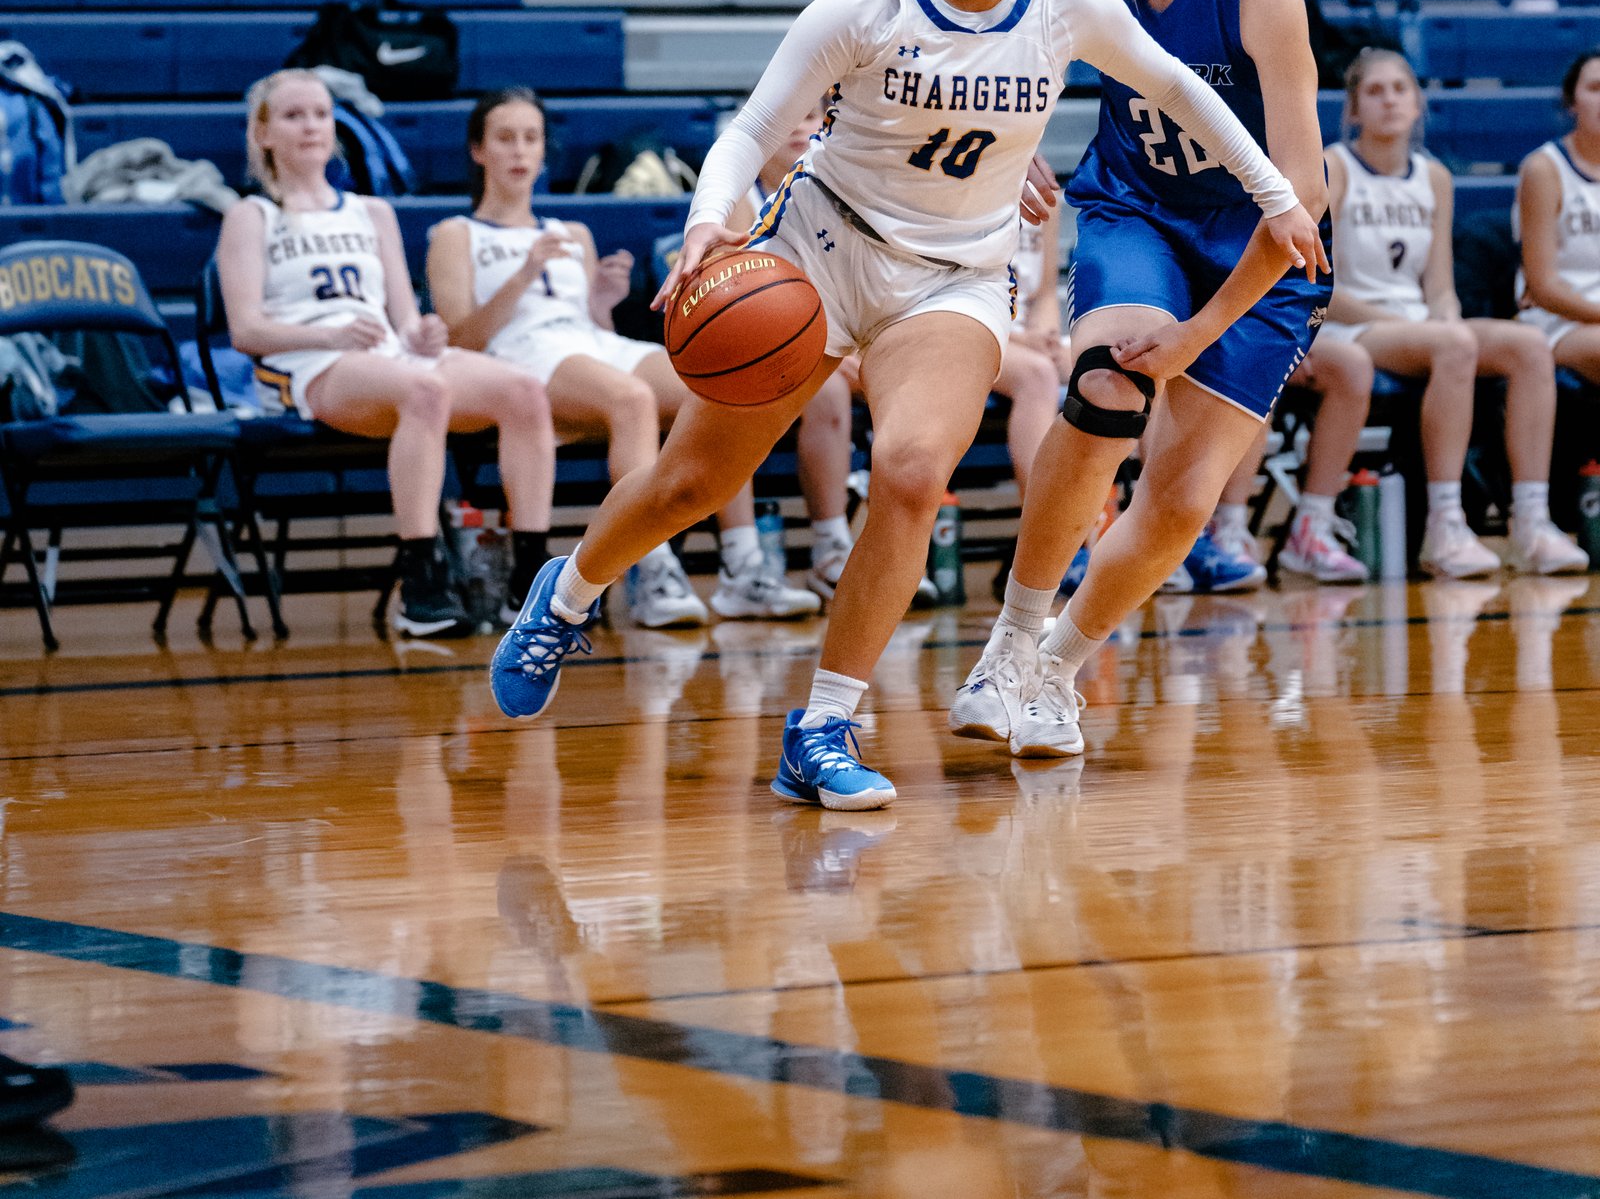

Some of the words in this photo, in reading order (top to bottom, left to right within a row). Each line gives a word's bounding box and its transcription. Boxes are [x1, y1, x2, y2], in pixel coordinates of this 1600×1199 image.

[884, 67, 1050, 113] CHARGERS
[906, 127, 998, 180] 10
[0, 255, 136, 310] BOBCATS
[309, 263, 367, 302] 20
[682, 257, 777, 315] EVOLUTION
